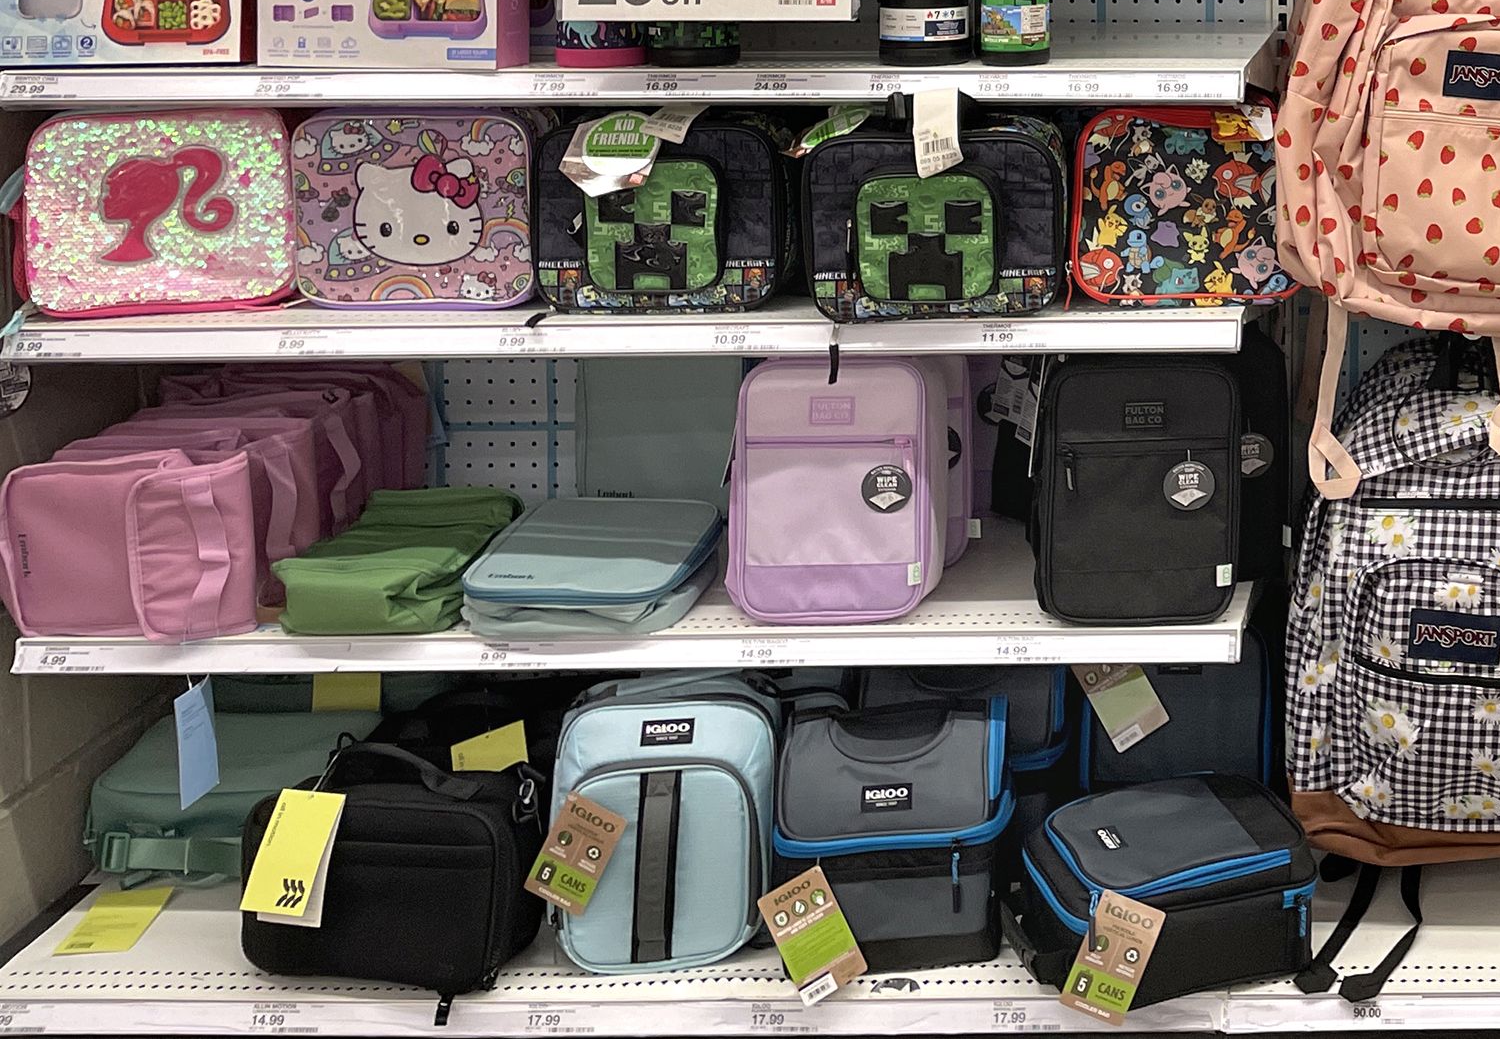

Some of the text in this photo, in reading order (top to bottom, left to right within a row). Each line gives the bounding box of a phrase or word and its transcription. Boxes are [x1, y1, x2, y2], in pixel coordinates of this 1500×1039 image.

[10, 84, 45, 94] 29.99
[256, 83, 291, 93] 29.99
[532, 82, 565, 91] 17.99
[645, 82, 678, 91] 16.99
[753, 82, 788, 91] 24.99
[869, 82, 902, 92] 19.99
[977, 82, 1010, 92] 18.99
[1067, 82, 1099, 92] 16.99
[1157, 82, 1189, 92] 16.99
[614, 118, 636, 131] KID
[591, 132, 650, 146] FRIENDLY
[499, 337, 526, 347] 9.99
[713, 335, 746, 345] 10.99
[982, 333, 1014, 343] 11.99
[16, 342, 42, 352] 9.99
[278, 339, 305, 350] 9.99
[1125, 403, 1164, 415] FULTON
[1125, 415, 1147, 425] BAG
[876, 475, 898, 483] WIPE
[1178, 478, 1200, 486] CLEAN
[876, 481, 898, 489] CLEAN
[1413, 623, 1498, 648] JANSPORT
[739, 648, 773, 658] 14.99
[997, 646, 1028, 656] 14.99
[40, 655, 67, 666] 4.99
[480, 652, 507, 662] 9.99
[645, 723, 691, 734] IGLOO
[864, 787, 909, 800] IGLOO
[569, 803, 616, 834] IGLOO
[560, 873, 587, 894] CANS
[773, 880, 812, 907] IGLOO
[1104, 902, 1155, 930] IGLOO
[1097, 982, 1126, 1002] CANS
[993, 1012, 1027, 1023] 17.99
[1353, 1007, 1382, 1018] 90.00
[252, 1014, 285, 1026] 14.99
[528, 1014, 561, 1026] 17.99
[752, 1013, 785, 1025] 17.99
